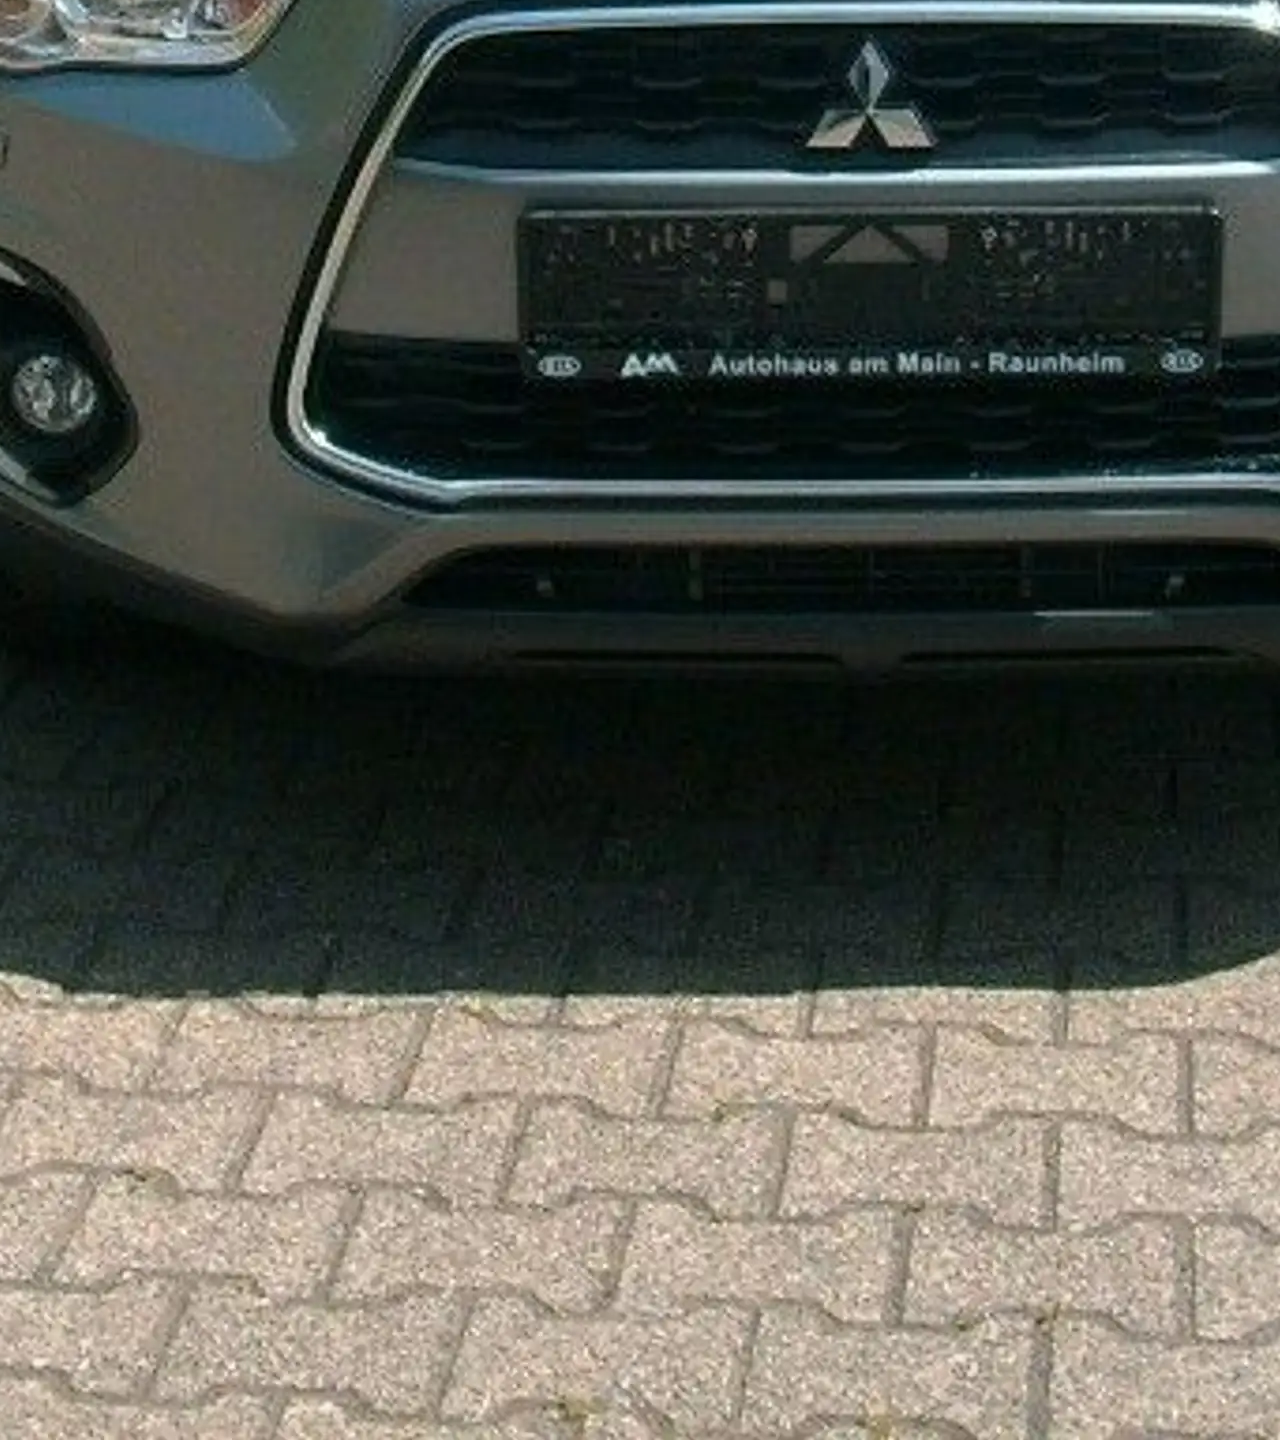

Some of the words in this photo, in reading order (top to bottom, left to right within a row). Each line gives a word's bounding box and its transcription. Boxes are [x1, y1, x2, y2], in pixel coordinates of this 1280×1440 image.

[708, 354, 838, 376] Autohaus
[849, 358, 888, 375] am
[897, 353, 962, 374] Main
[987, 352, 1125, 374] Raunheim
